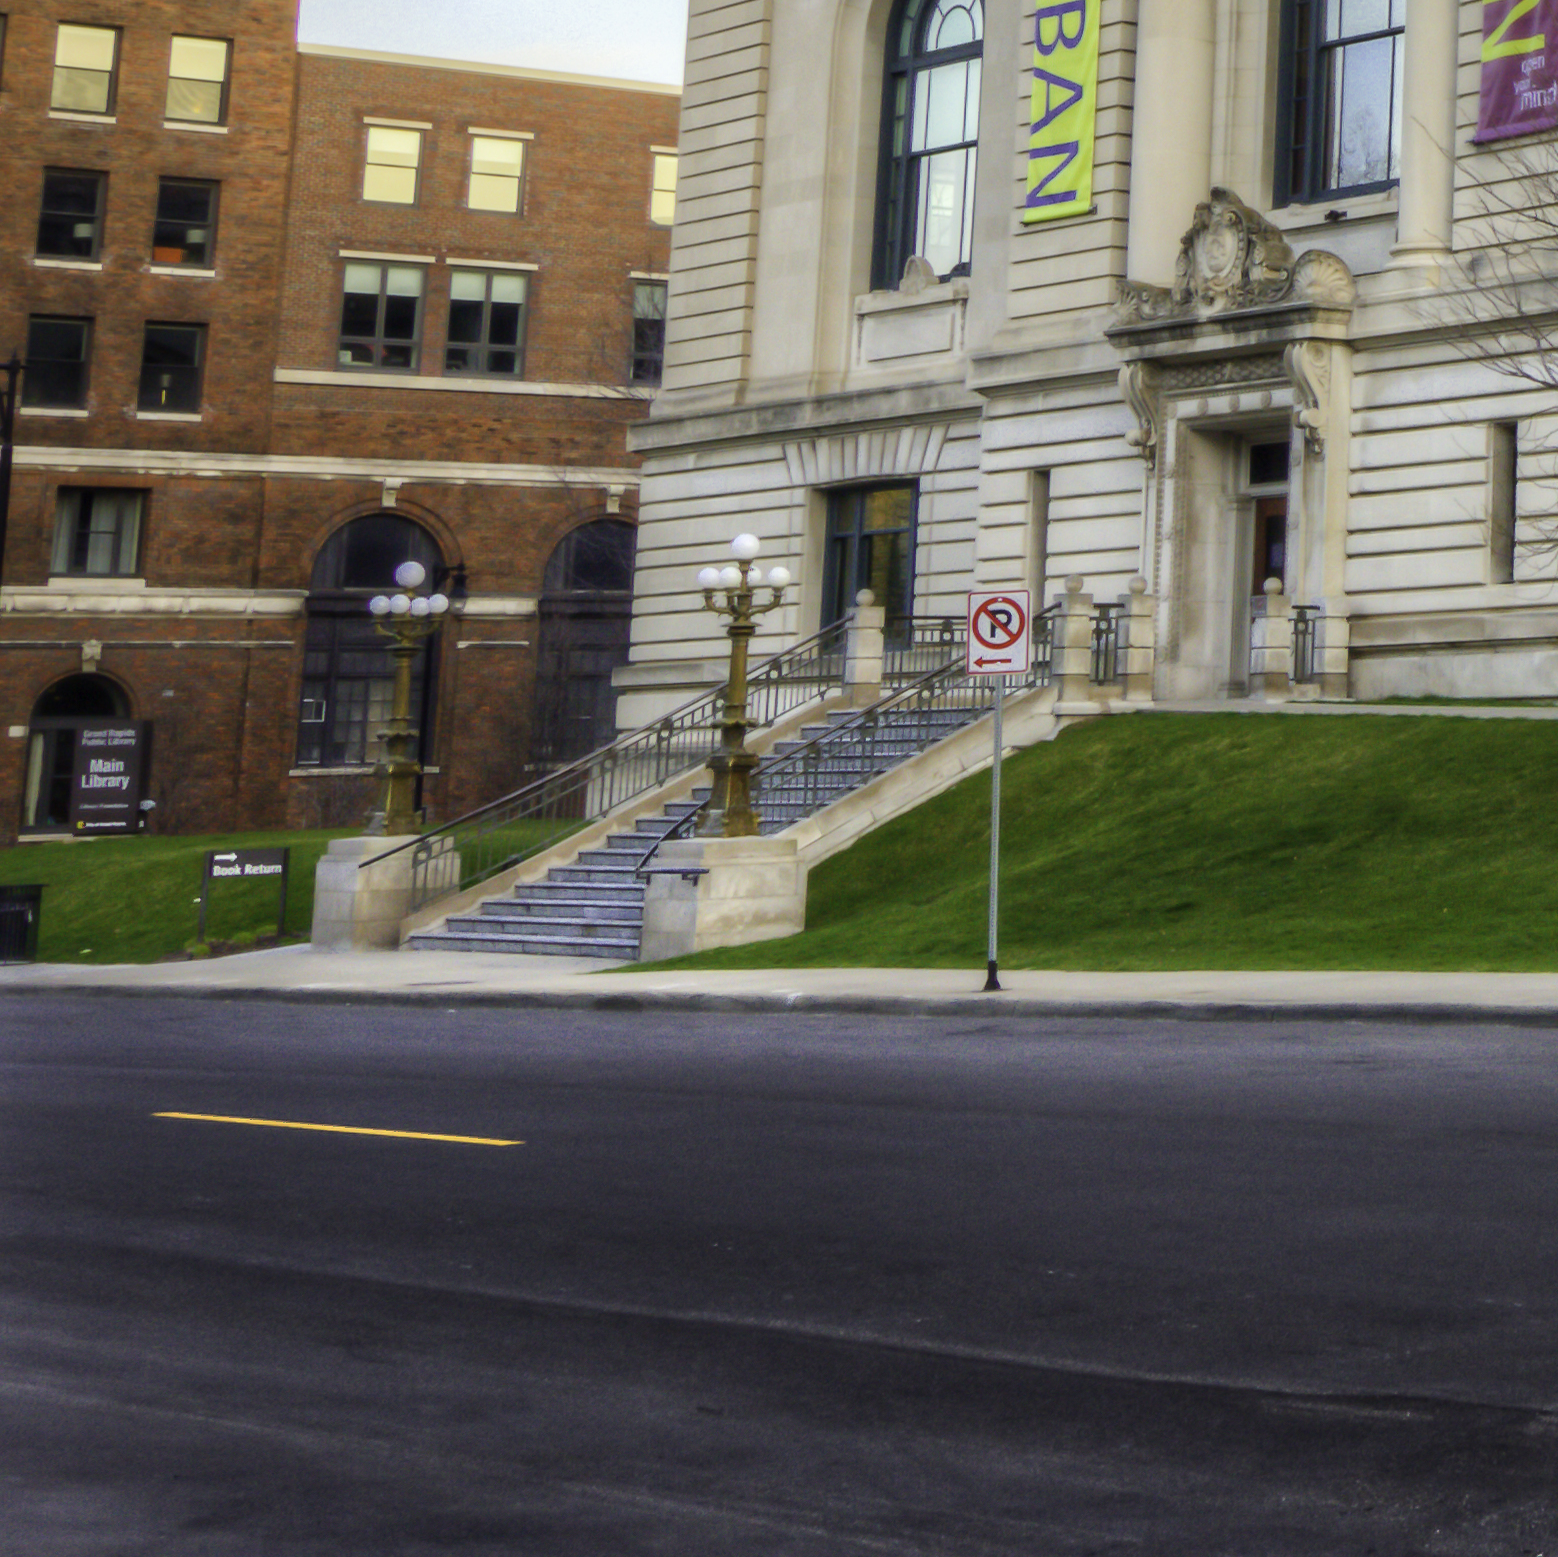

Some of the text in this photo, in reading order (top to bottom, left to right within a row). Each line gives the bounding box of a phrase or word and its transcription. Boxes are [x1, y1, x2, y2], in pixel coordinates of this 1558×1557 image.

[1521, 79, 1558, 110] mind
[989, 609, 1013, 639] P
[90, 759, 124, 773] Main
[81, 774, 131, 791] Library
[213, 864, 282, 876] Book Return
